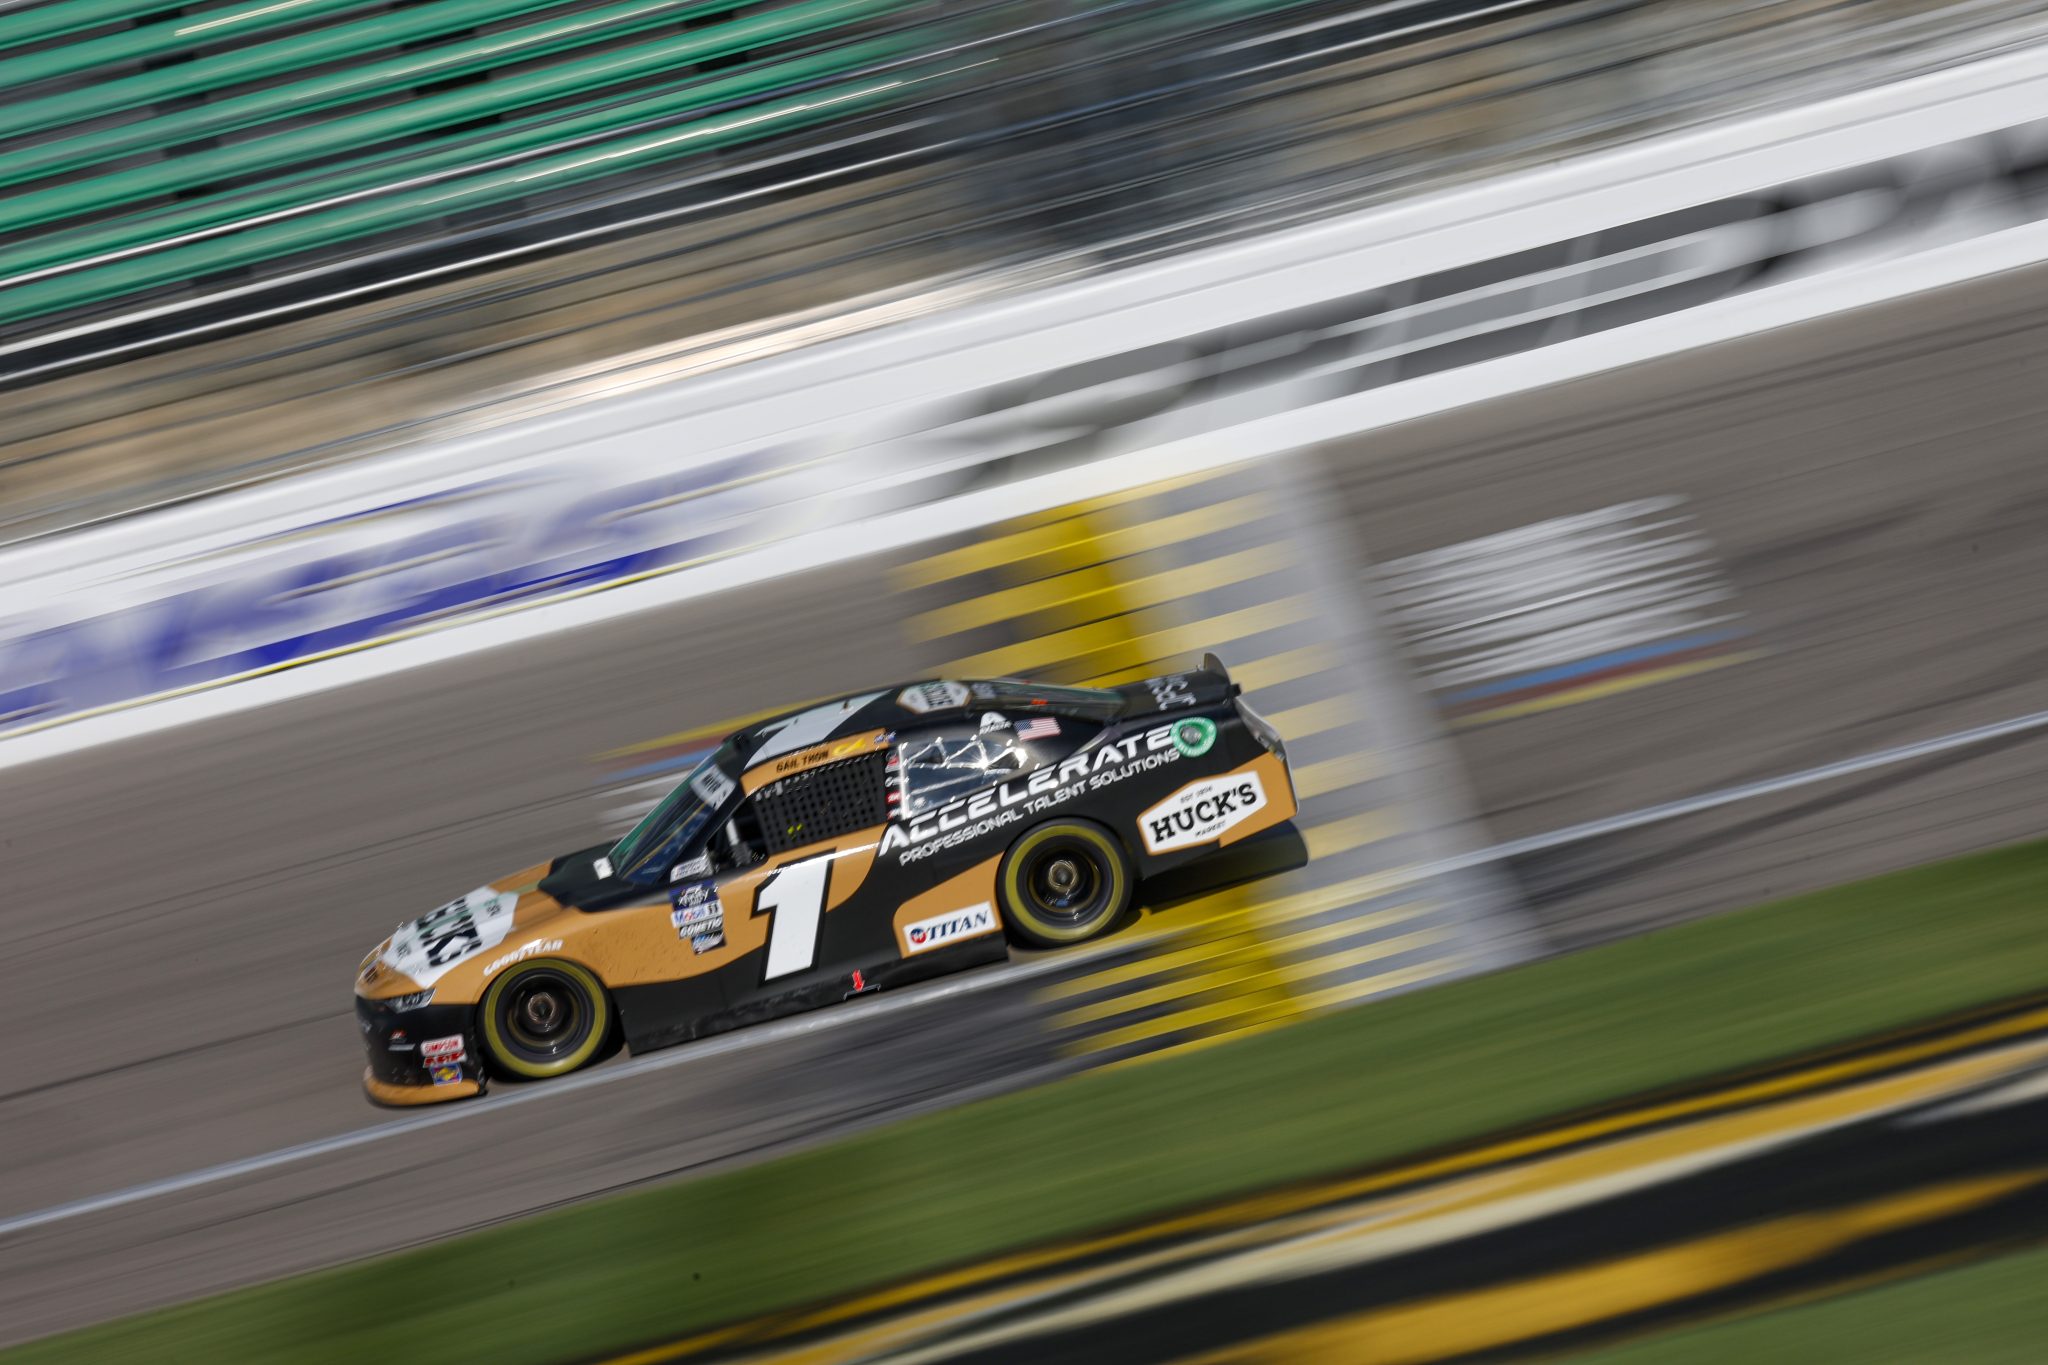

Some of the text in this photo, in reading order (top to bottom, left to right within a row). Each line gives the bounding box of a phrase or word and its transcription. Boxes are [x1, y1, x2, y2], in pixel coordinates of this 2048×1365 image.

[878, 723, 1174, 857] ACCELERATE
[899, 747, 1180, 866] PROFESSIONAL TALENT SOLUTIONS
[1149, 783, 1258, 843] HUCK'S
[755, 854, 832, 983] 1
[926, 909, 989, 941] TITAN
